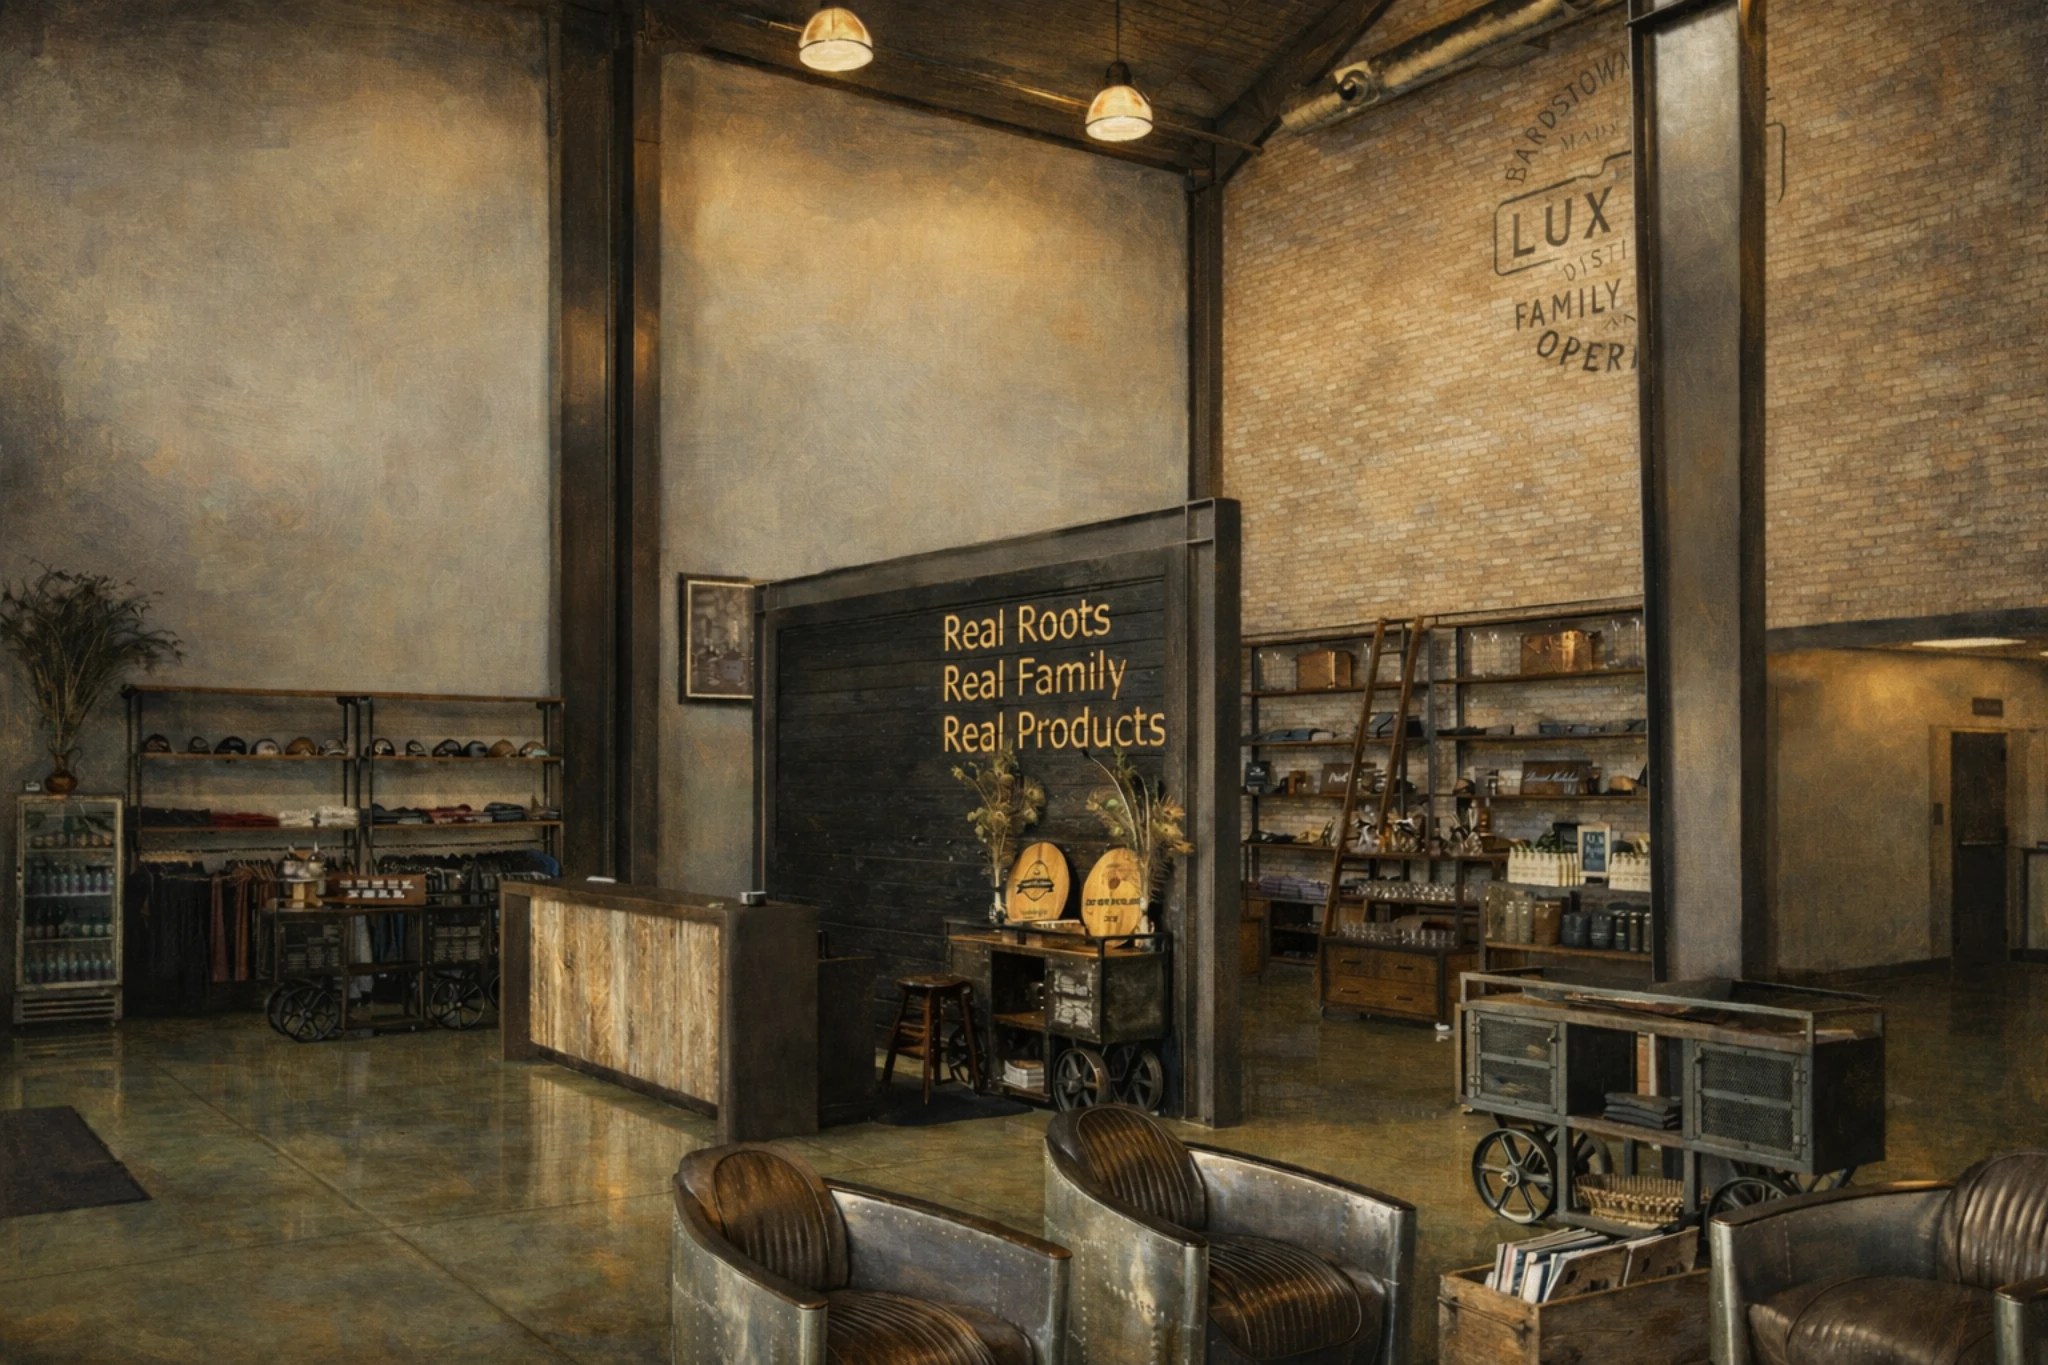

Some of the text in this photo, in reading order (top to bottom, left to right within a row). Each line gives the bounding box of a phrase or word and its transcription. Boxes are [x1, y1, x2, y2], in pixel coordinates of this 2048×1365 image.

[1512, 186, 1612, 258] LUX
[1515, 278, 1621, 331] FAMILY
[944, 599, 1111, 652] Real Roots
[943, 649, 1127, 702] Real Family
[943, 706, 1167, 753] Real Products
